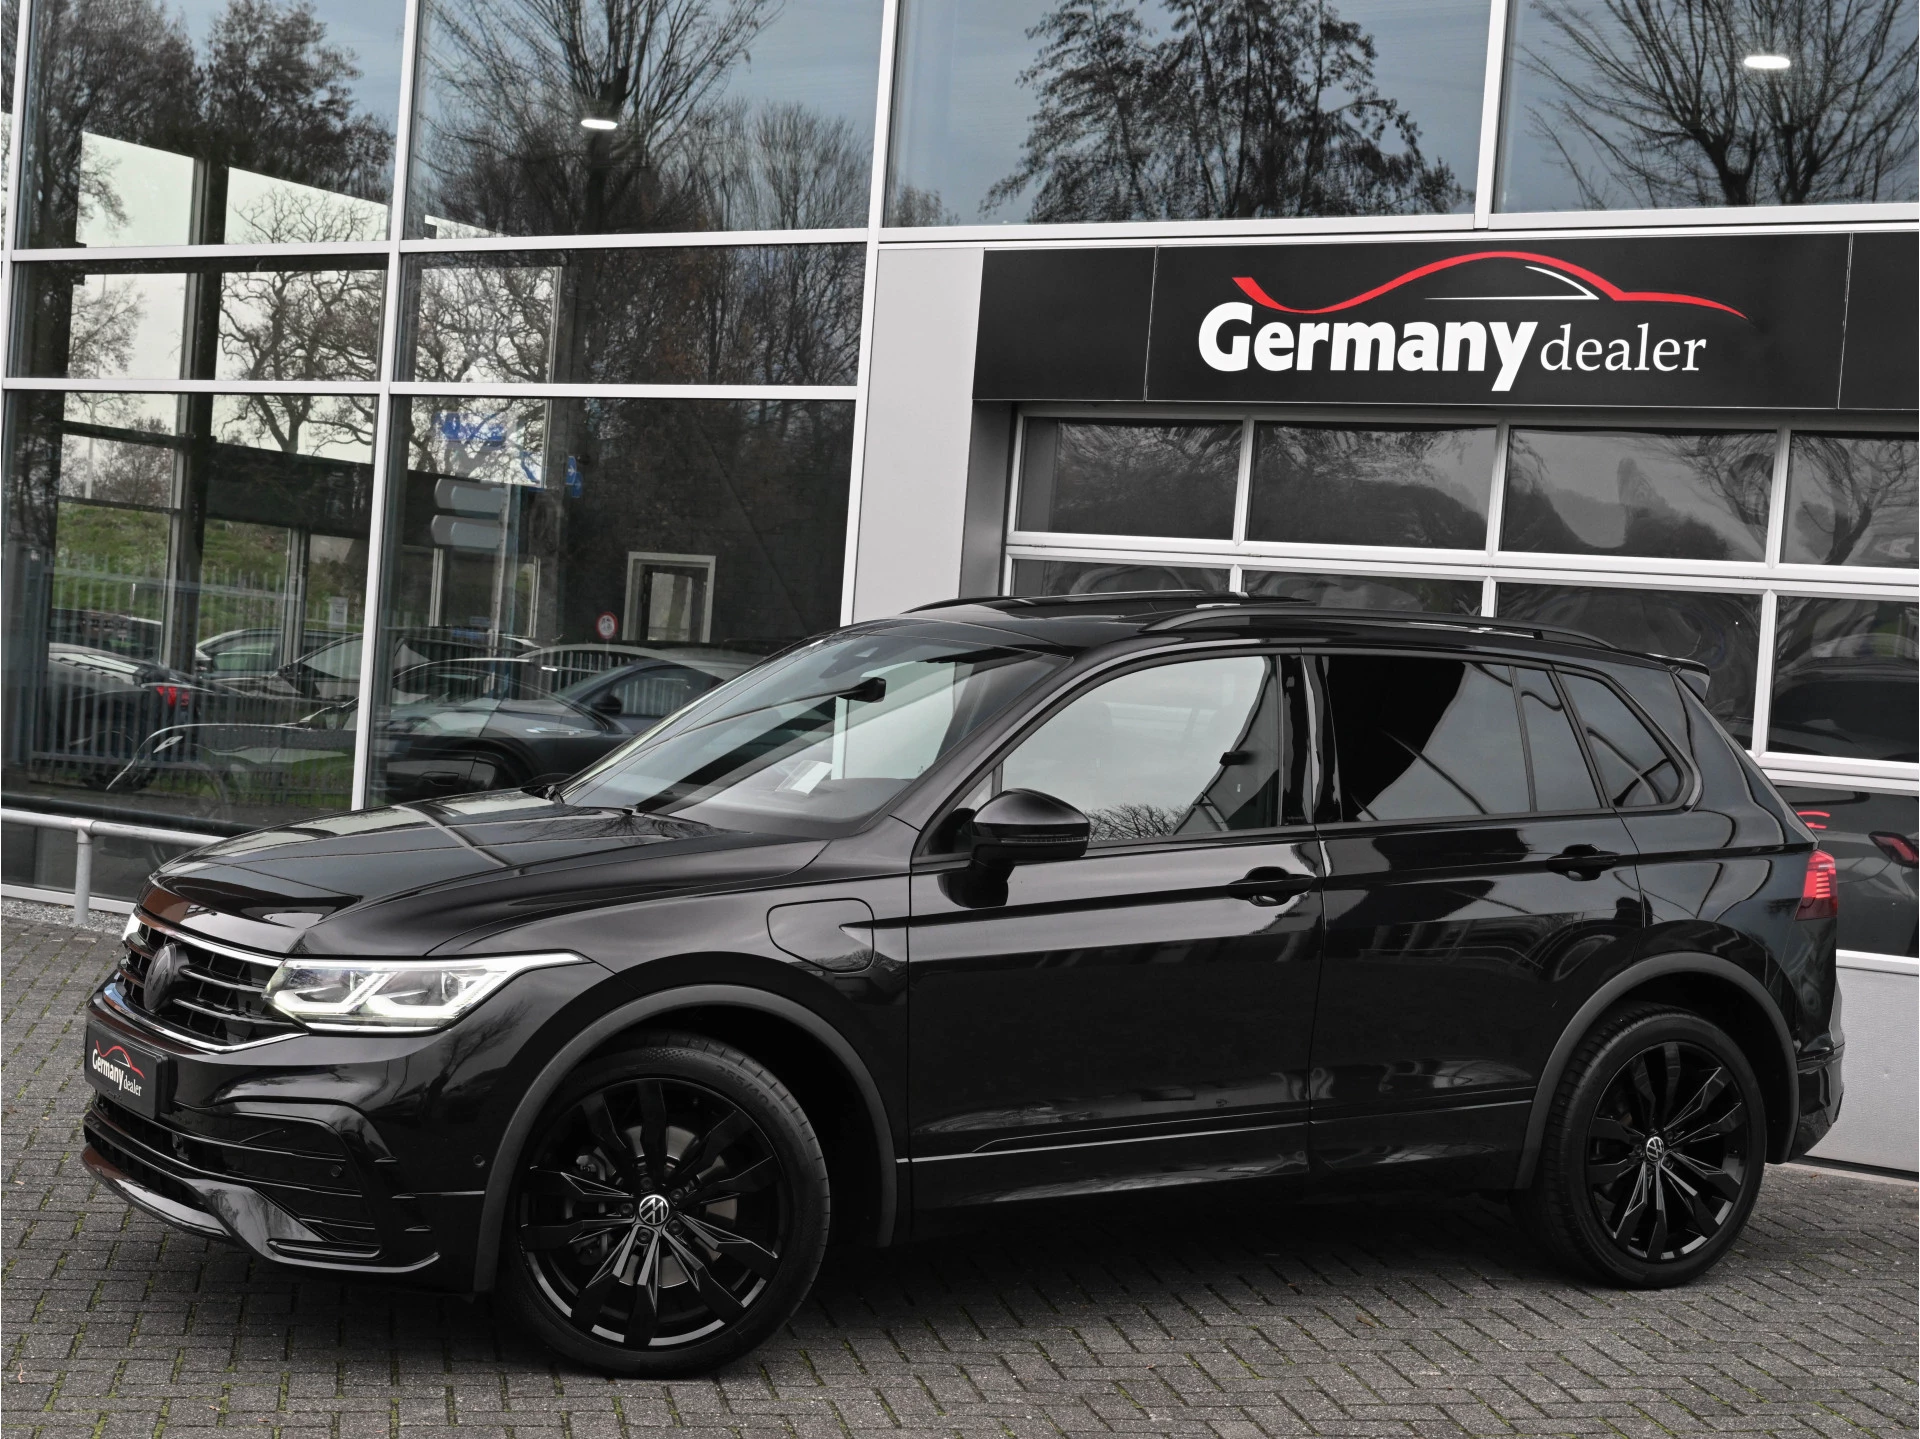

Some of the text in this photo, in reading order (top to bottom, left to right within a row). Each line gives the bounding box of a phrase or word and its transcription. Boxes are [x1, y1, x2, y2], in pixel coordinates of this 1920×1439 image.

[1198, 302, 1707, 392] Germany dealer
[92, 1049, 124, 1090] Germany
[123, 1074, 142, 1097] dealer
